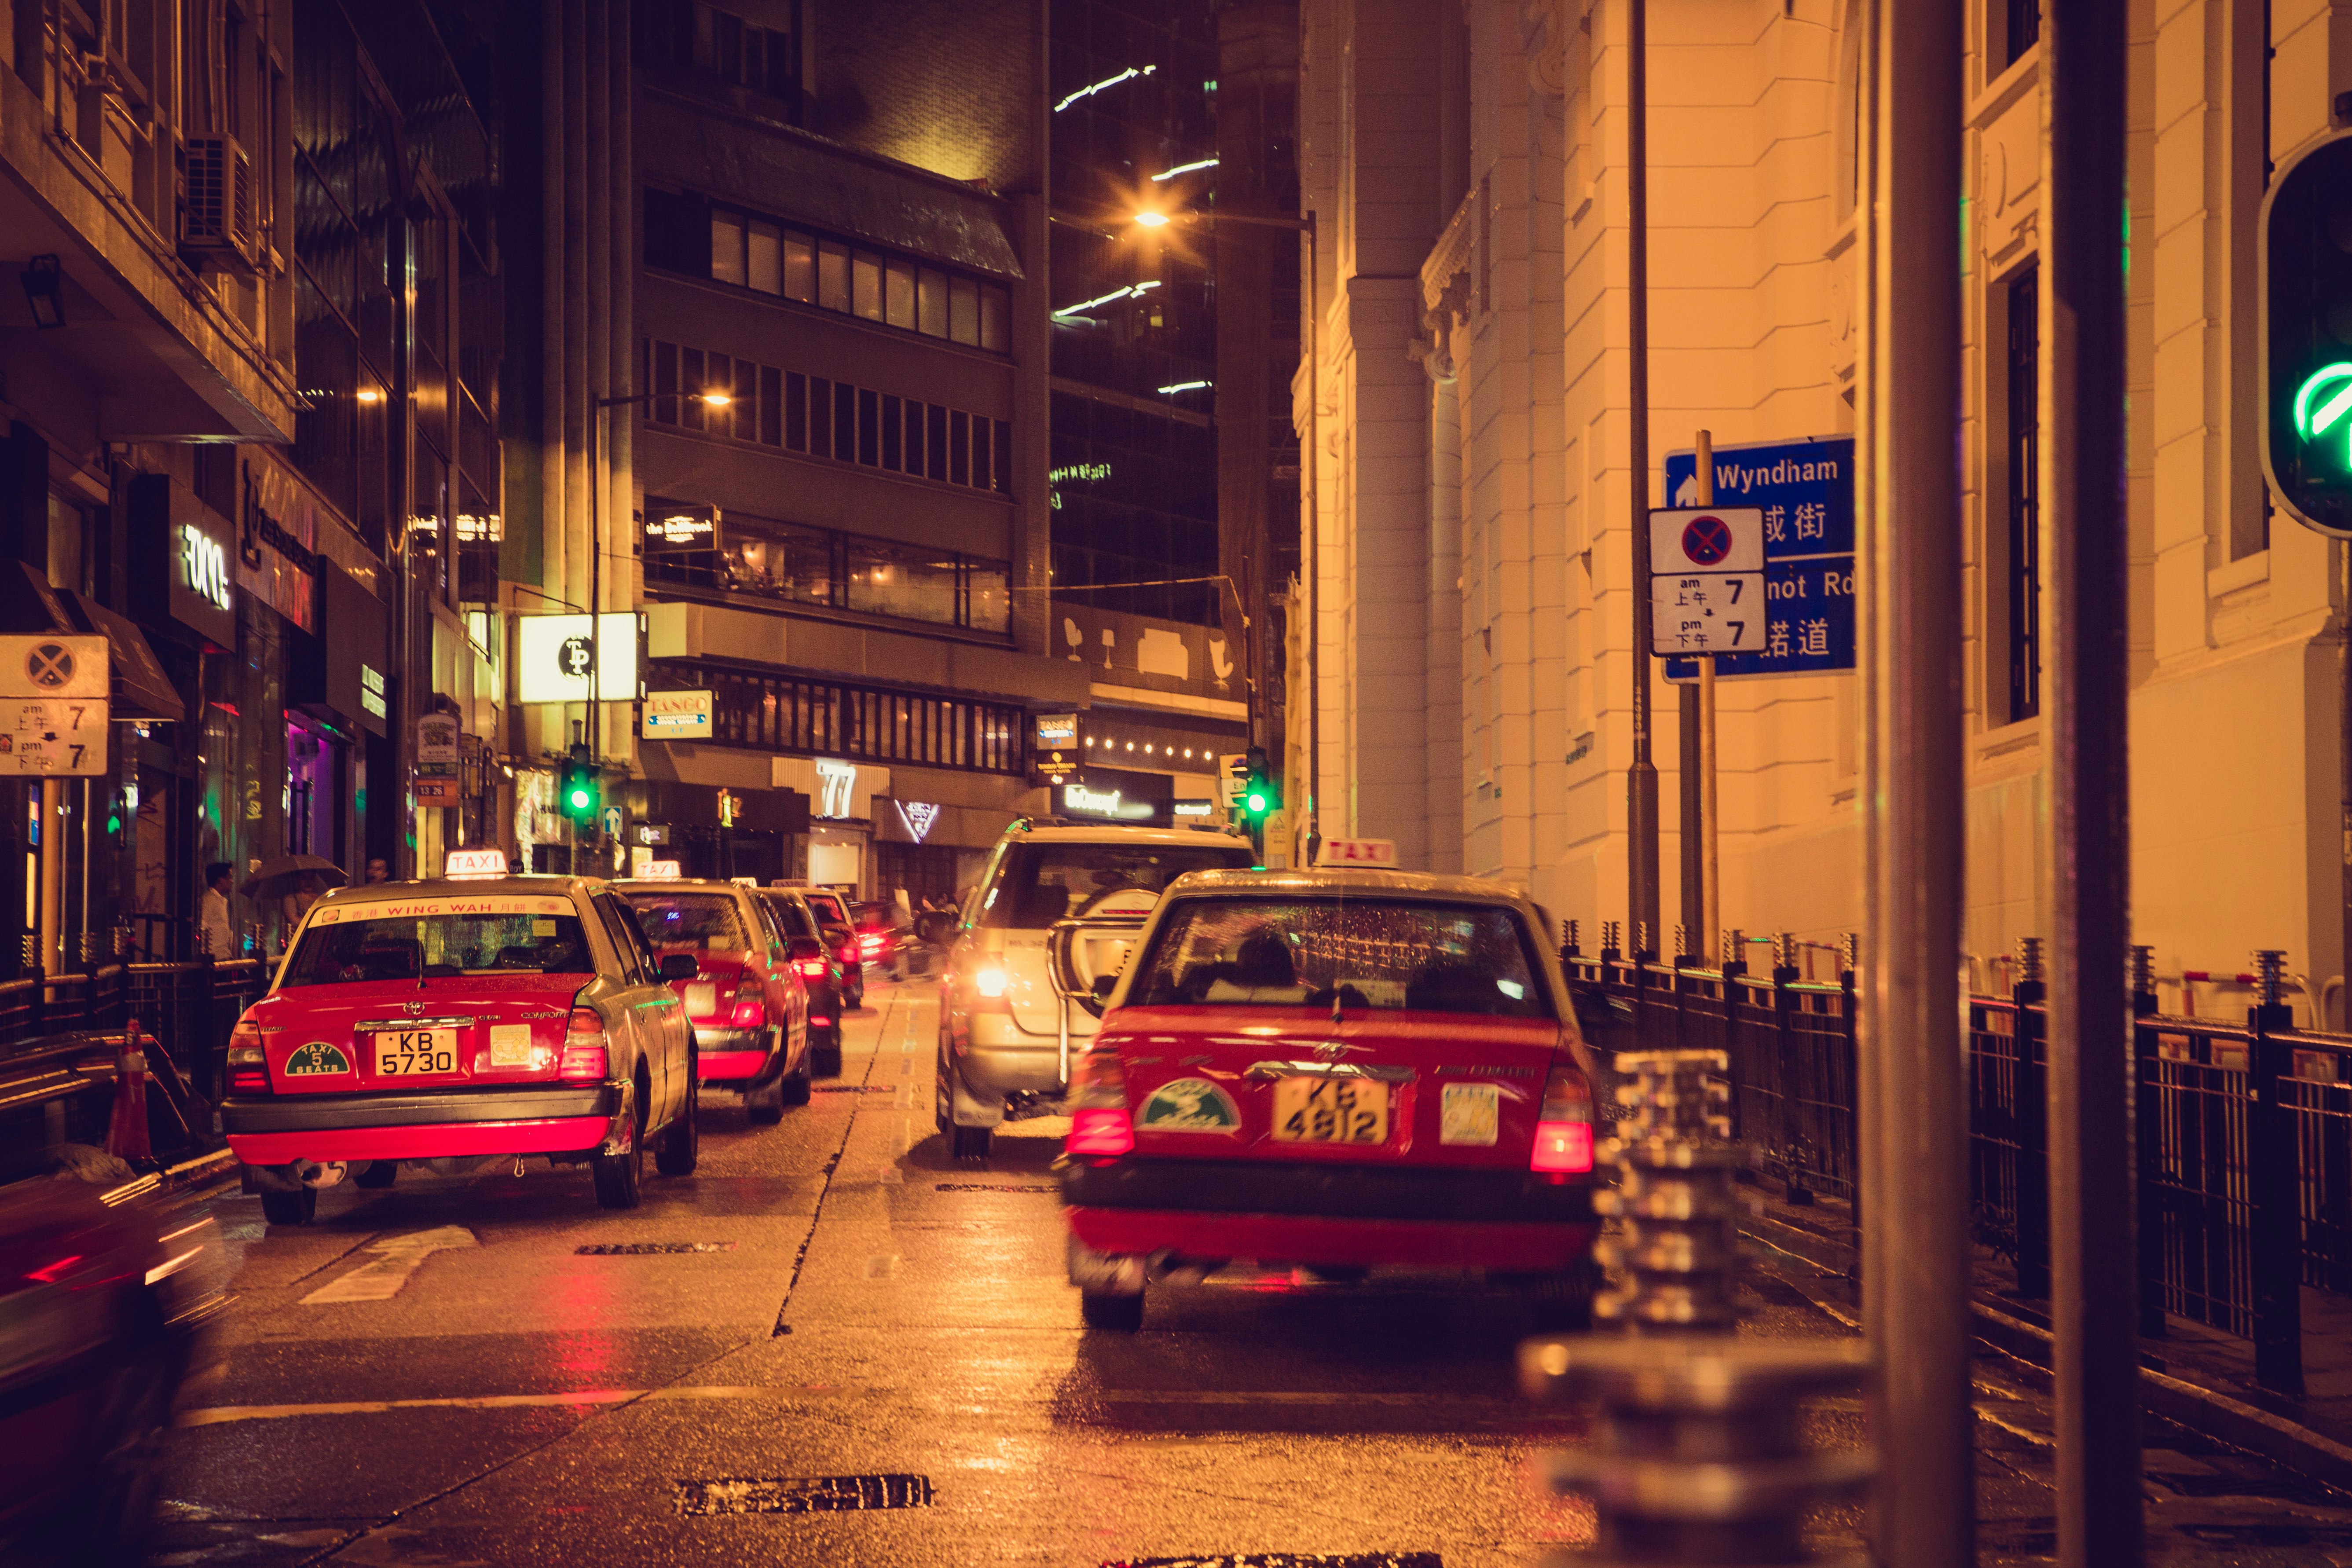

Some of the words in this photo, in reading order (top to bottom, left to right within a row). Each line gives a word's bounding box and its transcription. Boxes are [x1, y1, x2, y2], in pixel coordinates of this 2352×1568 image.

[1716, 459, 1838, 494] Wyndham
[1680, 579, 1700, 588] am
[1674, 592, 1707, 606] 上午
[1726, 580, 1743, 604] 7
[1681, 620, 1702, 632] pm
[1727, 621, 1744, 646] 7
[1675, 634, 1709, 648] 下午
[23, 706, 42, 714] am
[649, 696, 707, 713] TANGO
[70, 706, 85, 730] 7
[22, 742, 42, 753] pm
[69, 744, 85, 769] 7
[1330, 841, 1392, 862] TAXI
[452, 855, 498, 869] TAXI
[641, 864, 674, 875] TAXI
[388, 904, 440, 916] WING
[450, 903, 491, 912] WAH
[499, 902, 527, 912] 月餅
[301, 1044, 332, 1055] TAXI
[400, 1032, 433, 1053] KB
[311, 1052, 322, 1066] 5
[382, 1051, 451, 1074] 5730
[296, 1064, 339, 1074] SEATS
